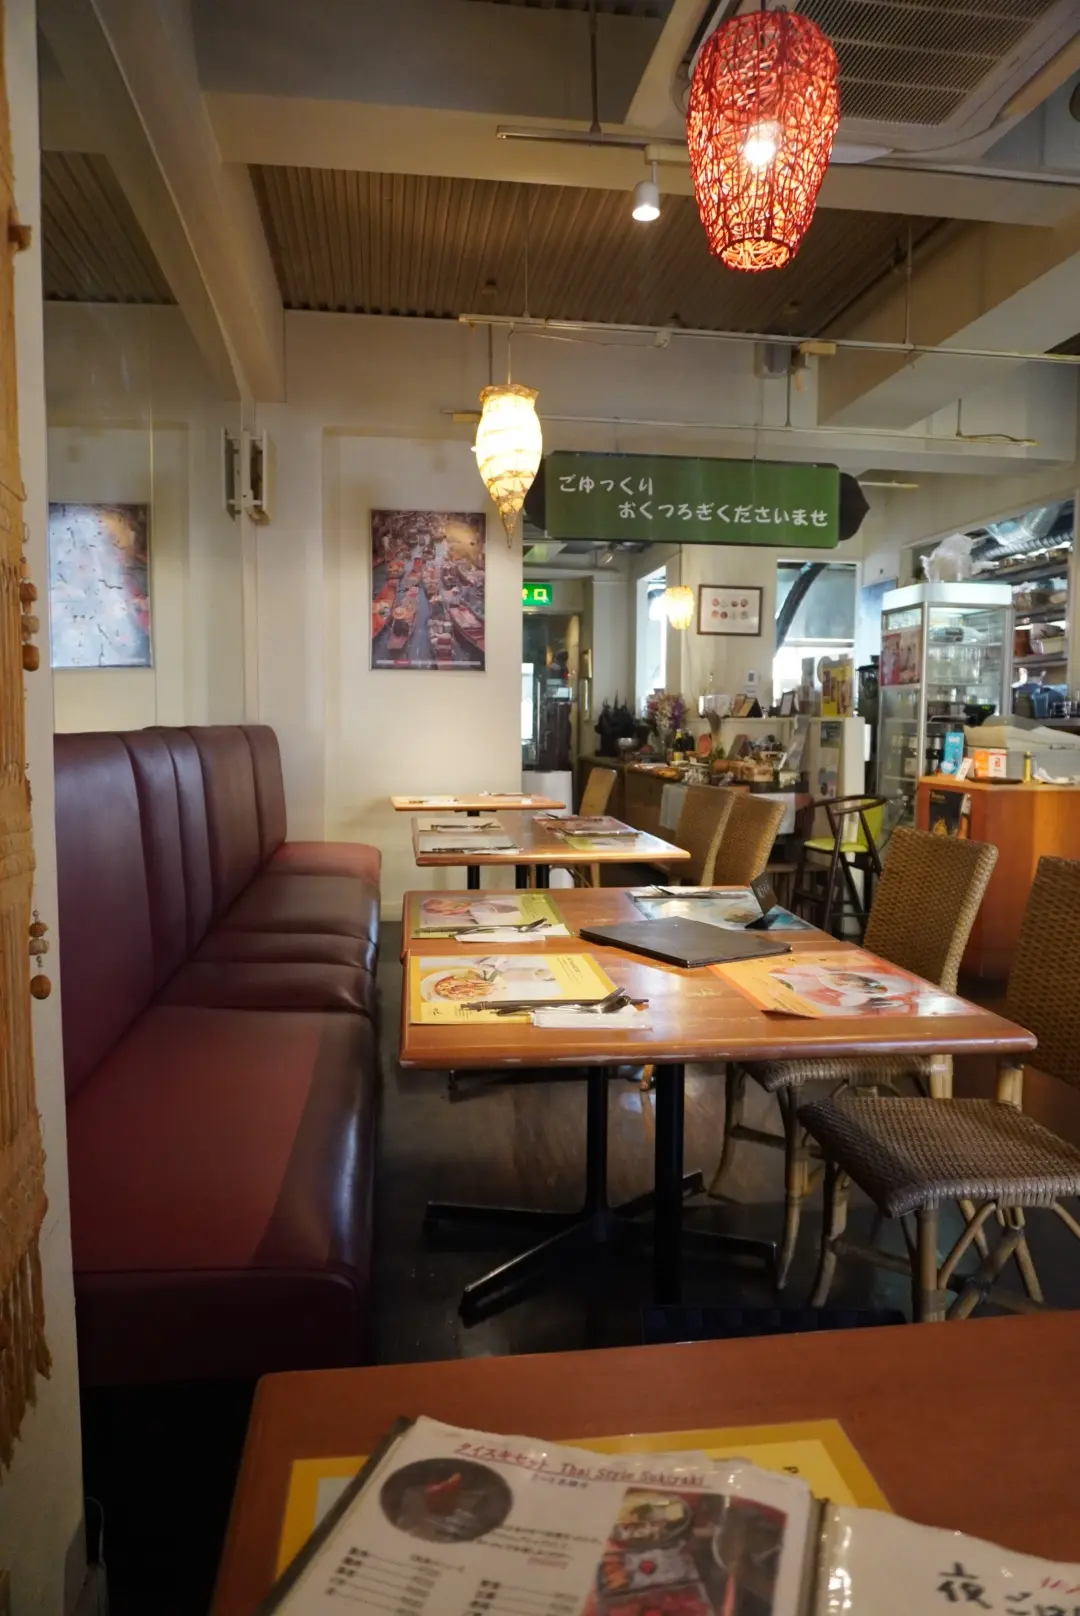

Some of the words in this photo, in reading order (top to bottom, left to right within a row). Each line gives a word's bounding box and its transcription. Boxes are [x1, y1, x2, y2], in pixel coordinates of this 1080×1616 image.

[558, 473, 654, 496] ごゆっくり
[617, 500, 829, 528] おくつろぎくださいませ
[560, 1462, 595, 1480] Thai
[594, 1469, 635, 1484] Style
